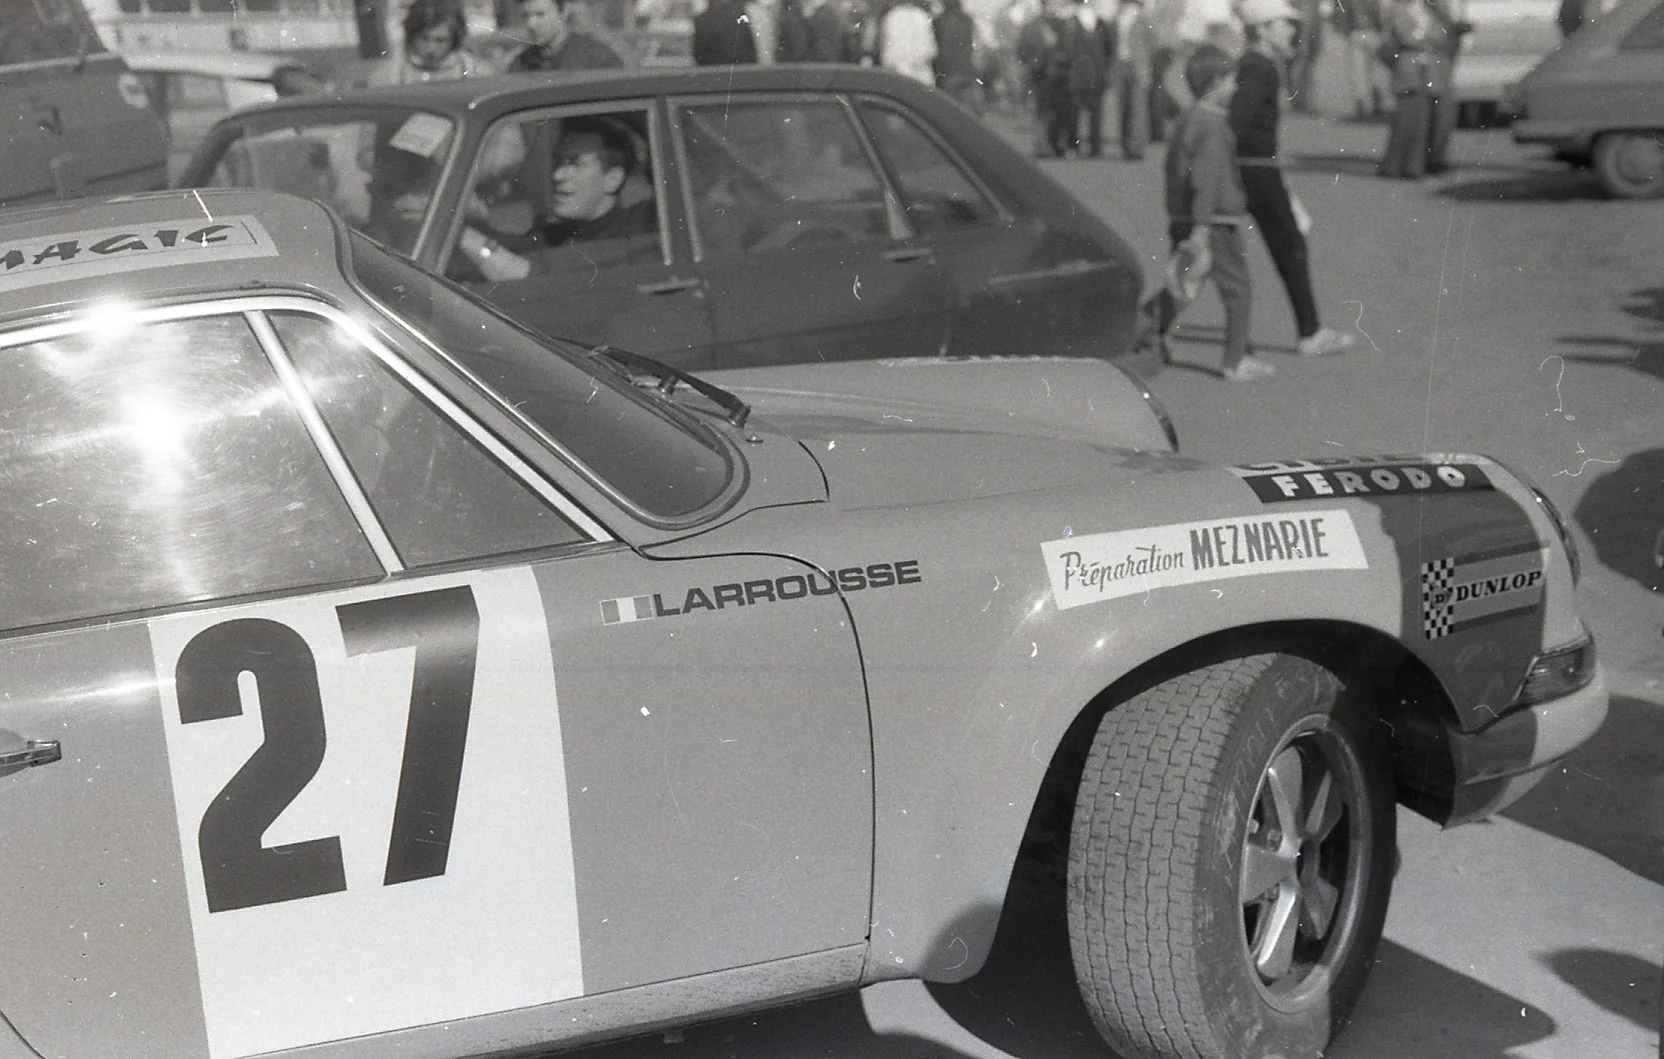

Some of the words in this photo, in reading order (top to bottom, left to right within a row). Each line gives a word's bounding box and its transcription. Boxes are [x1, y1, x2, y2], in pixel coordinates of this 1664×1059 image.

[1271, 465, 1467, 498] FERODO
[1189, 518, 1330, 571] MEZNARIE
[653, 560, 922, 617] LARROUSSE
[1456, 570, 1542, 602] DUNLOP
[175, 584, 481, 913] 27
